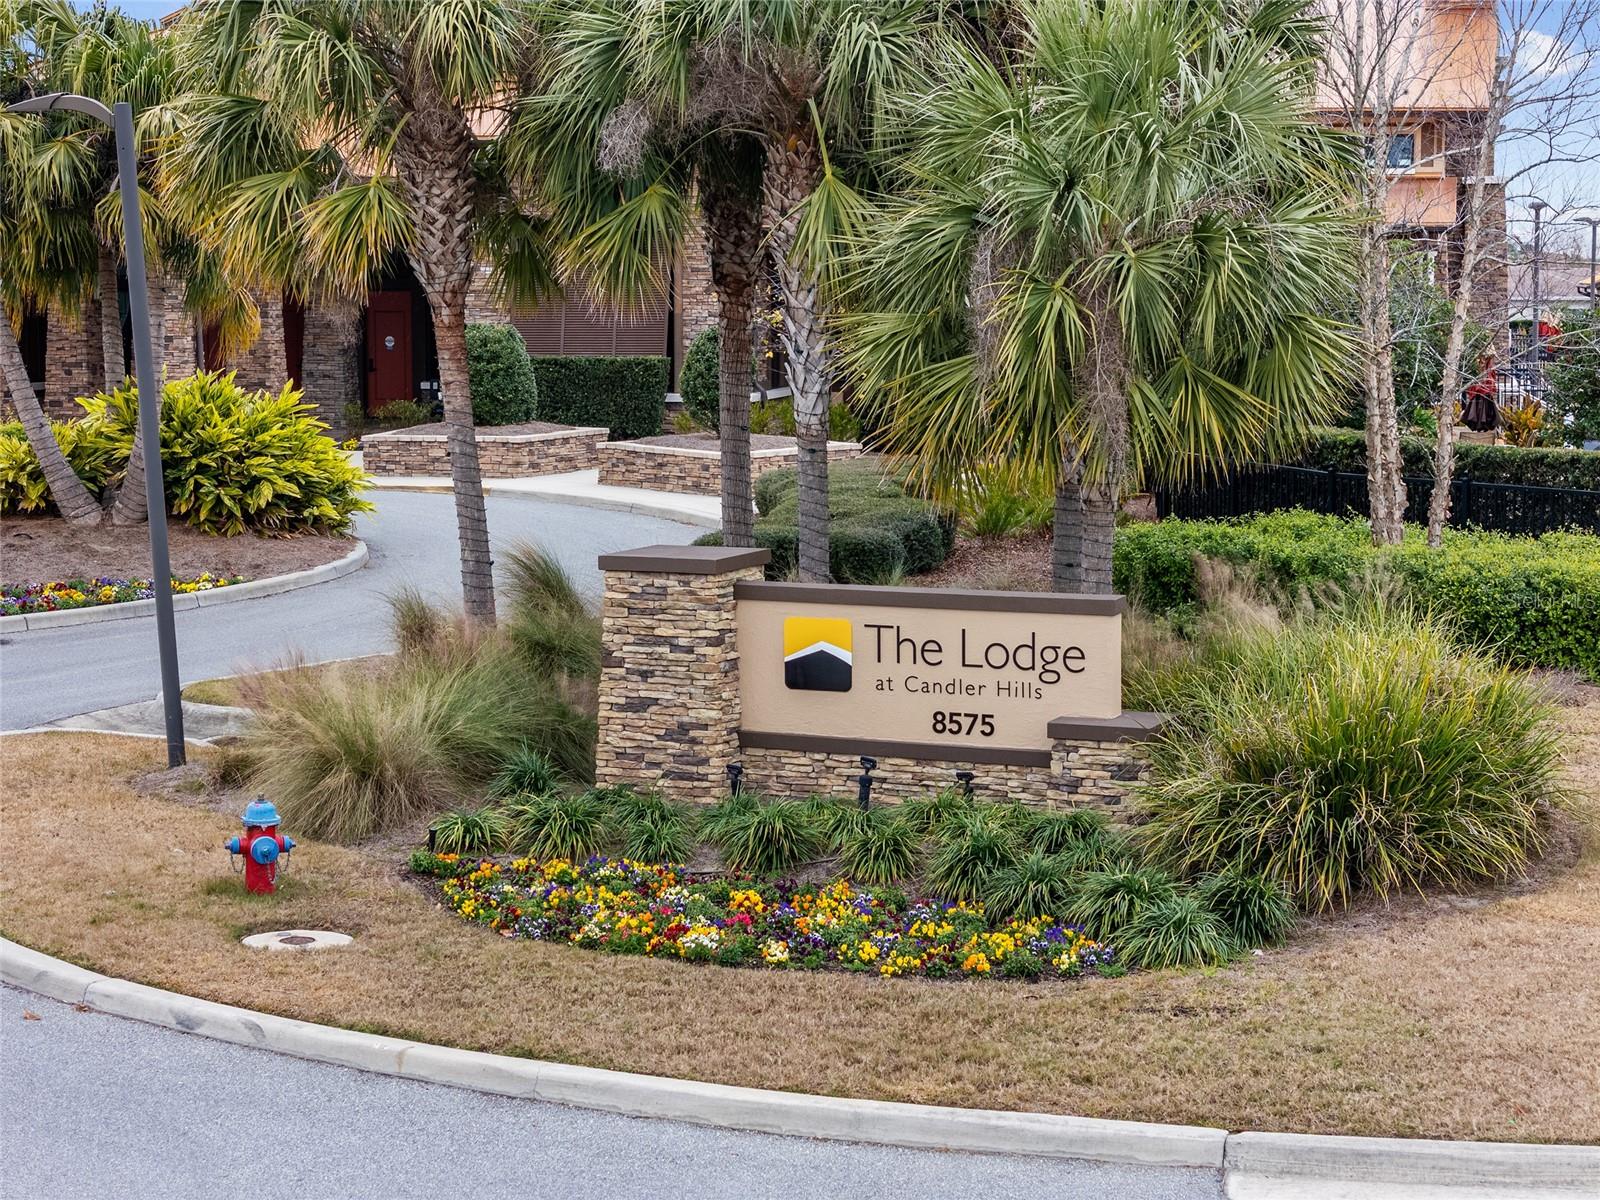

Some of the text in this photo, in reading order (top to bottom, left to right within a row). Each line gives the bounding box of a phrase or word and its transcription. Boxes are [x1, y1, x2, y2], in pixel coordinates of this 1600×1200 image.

[864, 624, 1086, 684] The Lodge
[875, 675, 1042, 699] at Candler Hills
[932, 711, 995, 737] 8575
